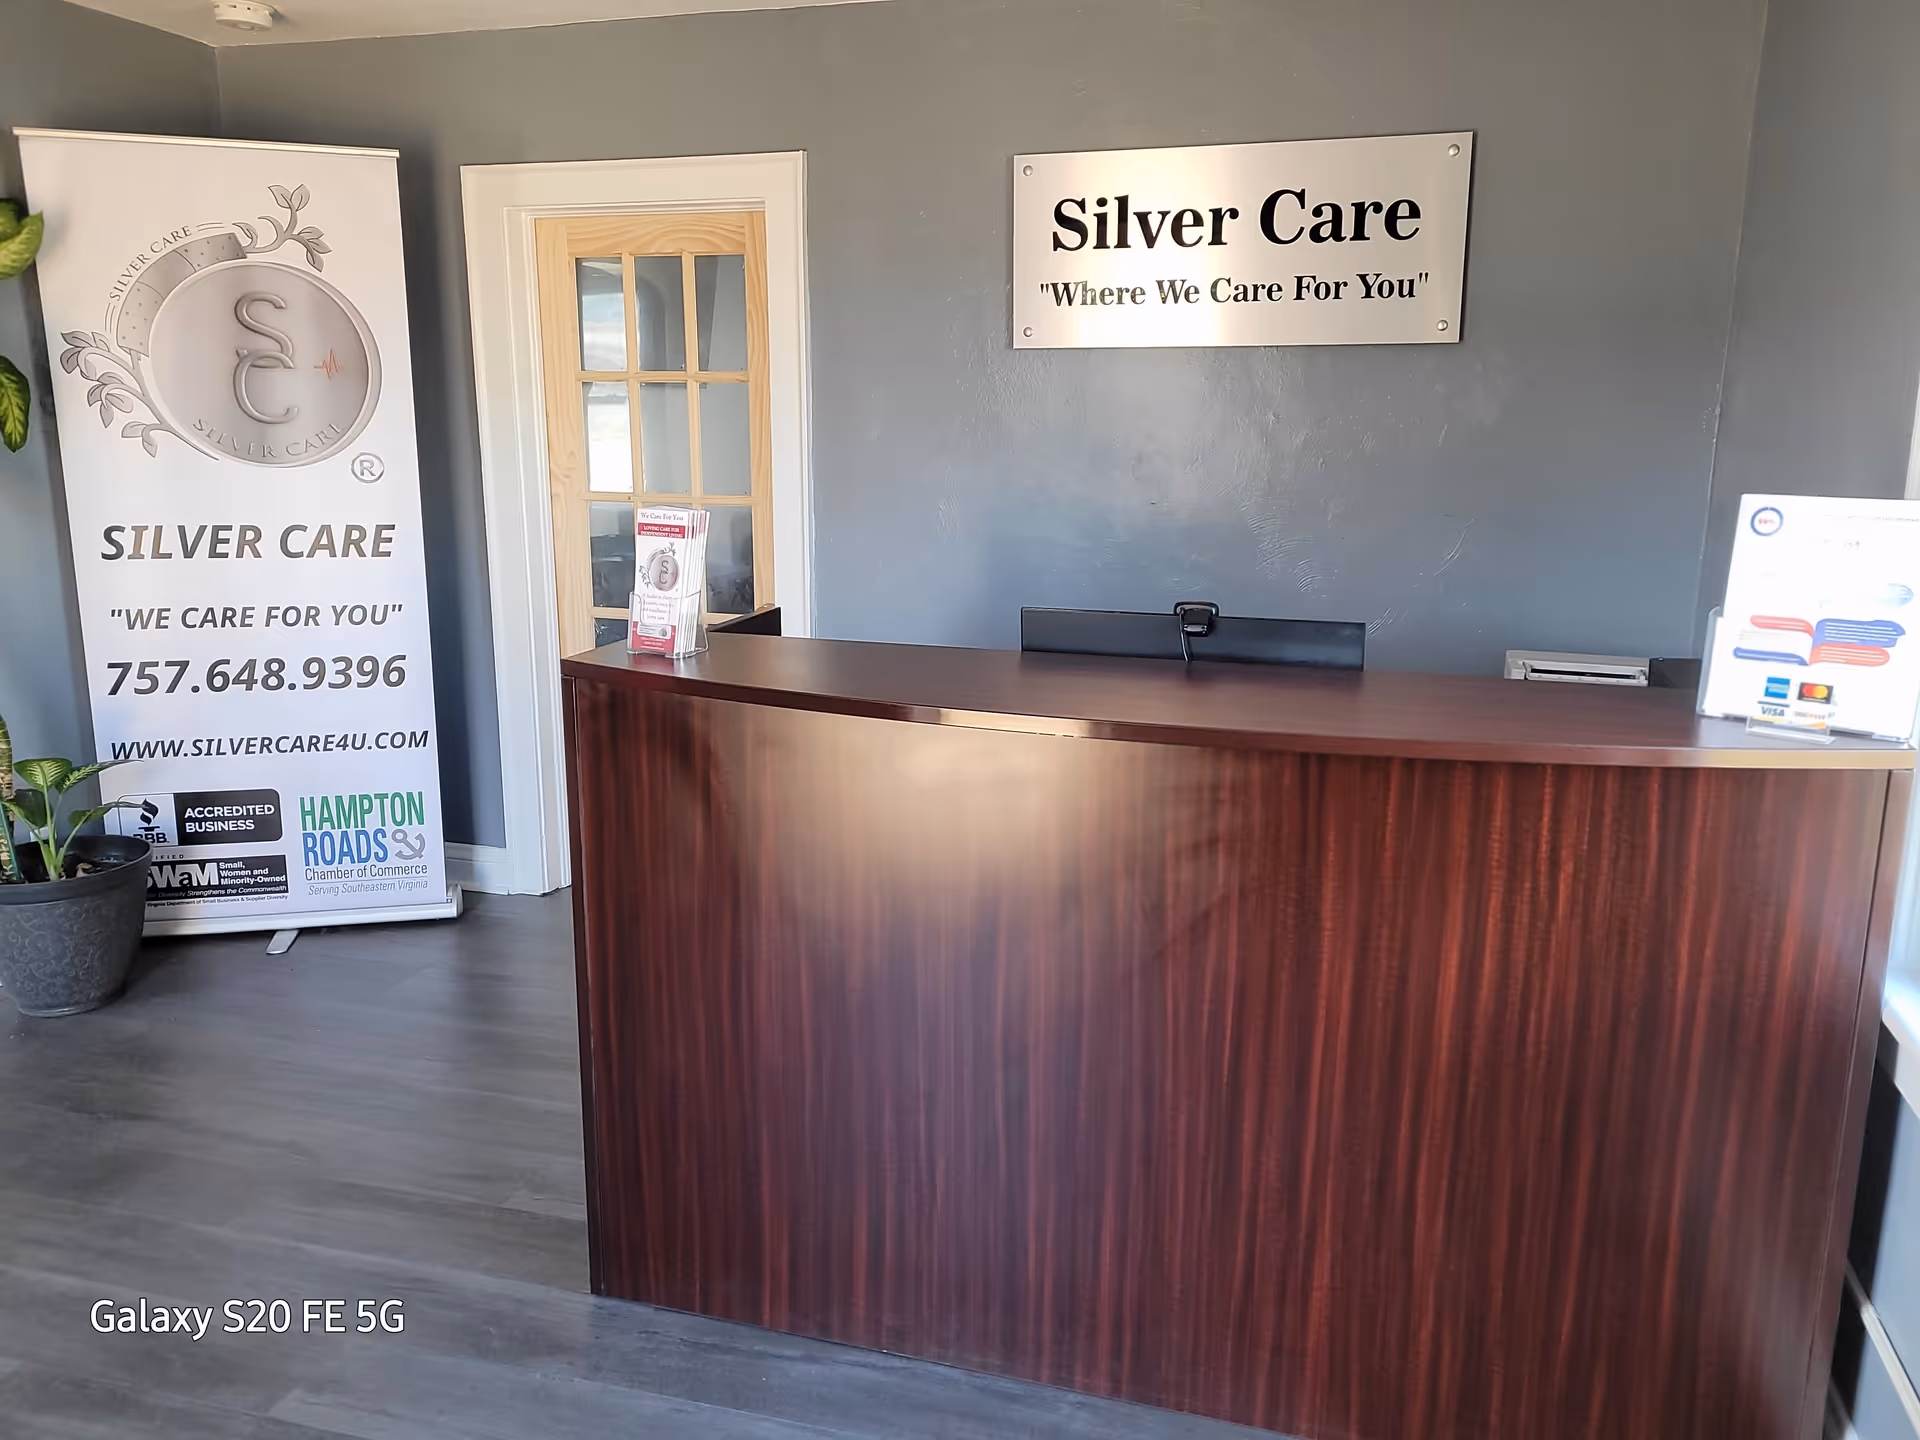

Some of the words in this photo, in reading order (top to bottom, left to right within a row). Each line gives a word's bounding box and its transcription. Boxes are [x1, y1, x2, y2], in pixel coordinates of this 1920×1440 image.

[1052, 193, 1239, 252] Silver
[1259, 188, 1422, 246] Care
[108, 253, 151, 301] SILVER
[150, 225, 192, 254] CARE
[1040, 280, 1146, 307] "Where
[1156, 278, 1200, 304] We
[1210, 276, 1283, 303] Care
[1293, 273, 1348, 301] For
[1356, 271, 1430, 299] You"
[100, 523, 262, 560] SILVER
[279, 523, 396, 559] CARE
[110, 607, 170, 630] "WE
[180, 606, 255, 629] CARE
[264, 605, 321, 628] FOR
[331, 603, 403, 626] YOU"
[106, 654, 407, 696] 757.648.9396
[1761, 706, 1785, 717] VISA
[110, 730, 429, 760] WWW.SILVERCARE4U.COM
[184, 804, 275, 818] ACCREDITED
[299, 791, 425, 831] HAMPTON
[185, 820, 255, 832] BUSINESS
[302, 828, 389, 866] ROADS
[219, 861, 246, 870] Small,
[220, 869, 251, 877] Women
[253, 867, 269, 875] and
[305, 866, 355, 881] Chamber
[357, 865, 367, 878] of
[369, 864, 428, 877] Commerce
[220, 874, 286, 885] Minority-Owned
[308, 884, 340, 896] Serving
[342, 880, 395, 894] Southeastern
[397, 879, 428, 891] Virginia
[187, 888, 225, 897] Strengthens
[238, 885, 287, 894] Commonwealth
